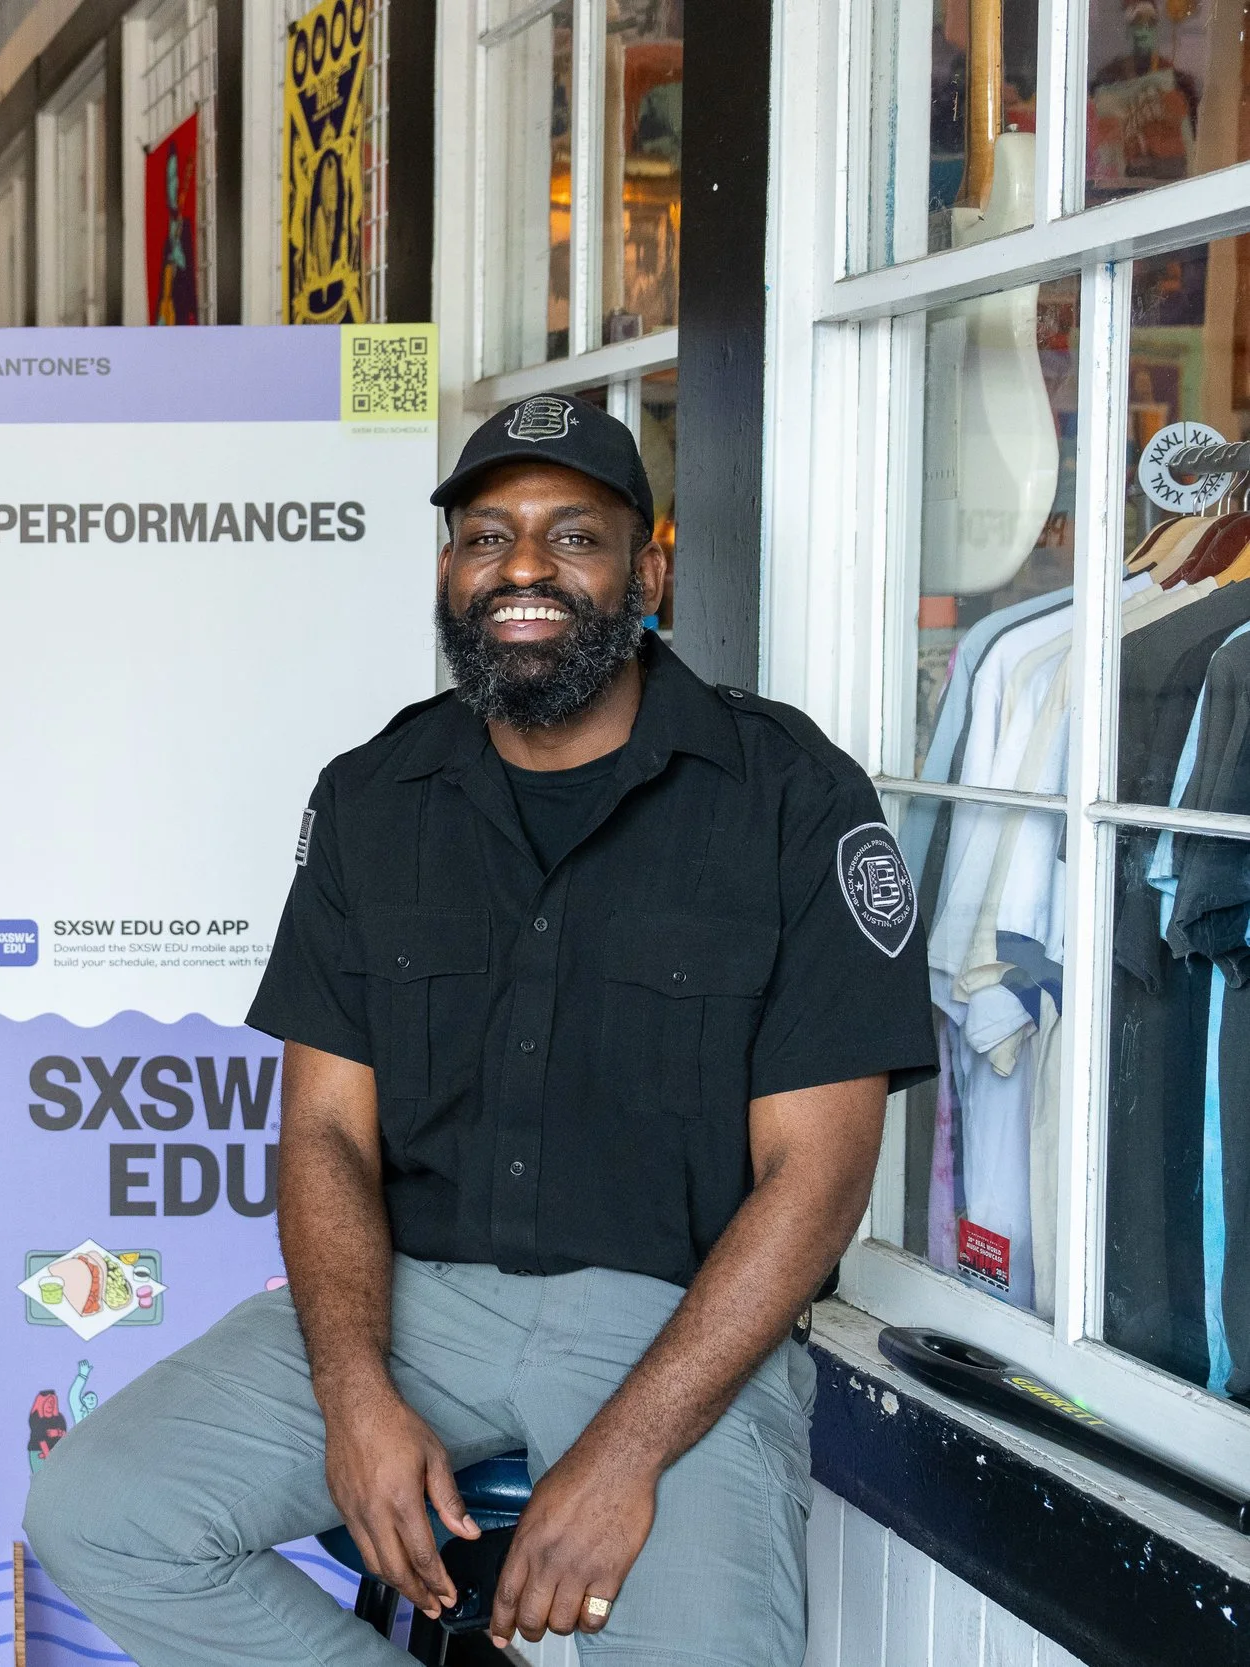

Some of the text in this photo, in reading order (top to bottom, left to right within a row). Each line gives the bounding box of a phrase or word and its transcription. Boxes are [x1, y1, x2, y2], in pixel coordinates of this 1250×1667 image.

[1149, 432, 1183, 465] XXXL
[848, 843, 871, 876] PERSONAL
[892, 905, 910, 926] TEXAS
[54, 920, 249, 935] SXSW EDU GO APP
[3, 943, 26, 954] EDU
[54, 943, 106, 953] Download
[108, 943, 126, 953] the
[129, 943, 162, 953] SXSW
[165, 943, 188, 952] EDU
[191, 943, 226, 952] mobile
[229, 945, 249, 955] app
[252, 943, 264, 952] to
[54, 957, 78, 967] build
[81, 959, 106, 969] your
[109, 957, 158, 968] schedule,
[160, 957, 180, 967] and
[183, 957, 225, 967] connect
[229, 957, 251, 966] with
[29, 1055, 279, 1131] SXSW
[109, 1143, 279, 1218] EDU
[980, 1248, 1003, 1264] SHOWCASE
[986, 1244, 1002, 1256] WORLD
[1011, 1377, 1105, 1425] GARRETT
